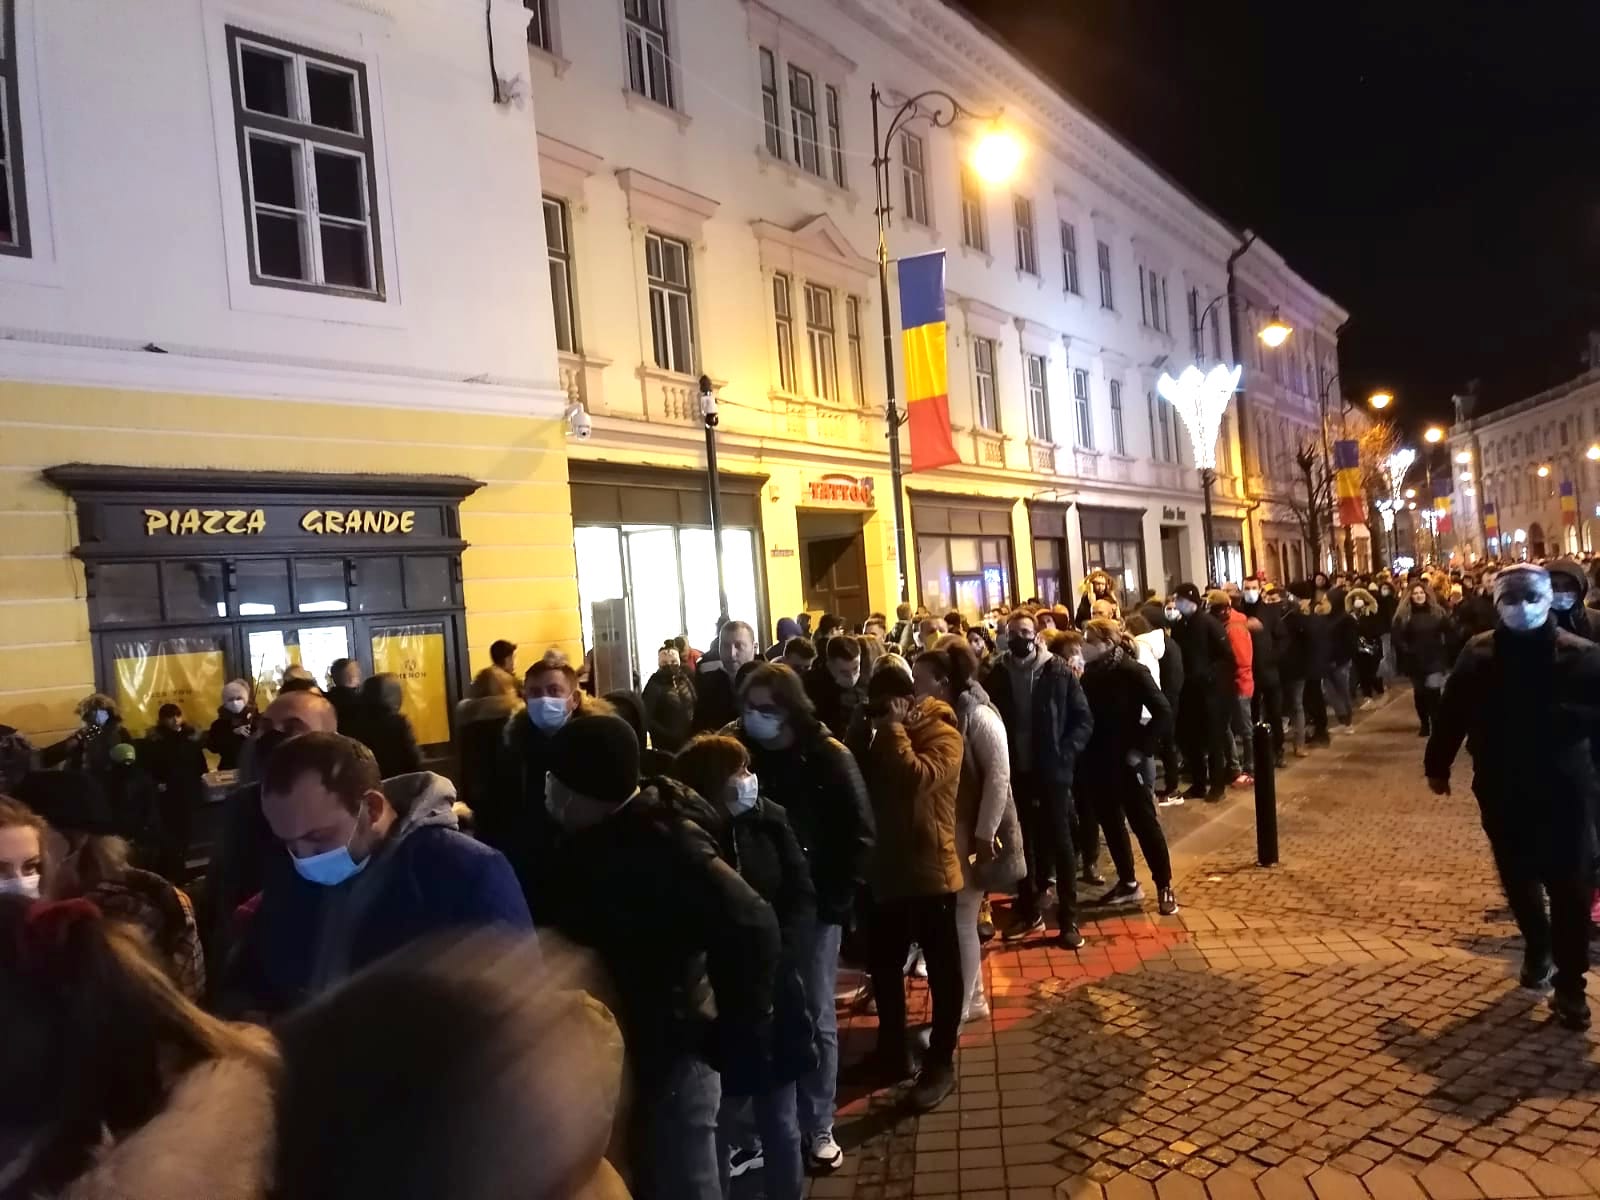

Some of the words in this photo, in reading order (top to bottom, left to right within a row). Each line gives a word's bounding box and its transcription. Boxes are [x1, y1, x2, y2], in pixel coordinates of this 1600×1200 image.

[809, 481, 871, 503] TATTOO
[143, 508, 266, 536] PIAZZA
[301, 509, 416, 535] GRANDE
